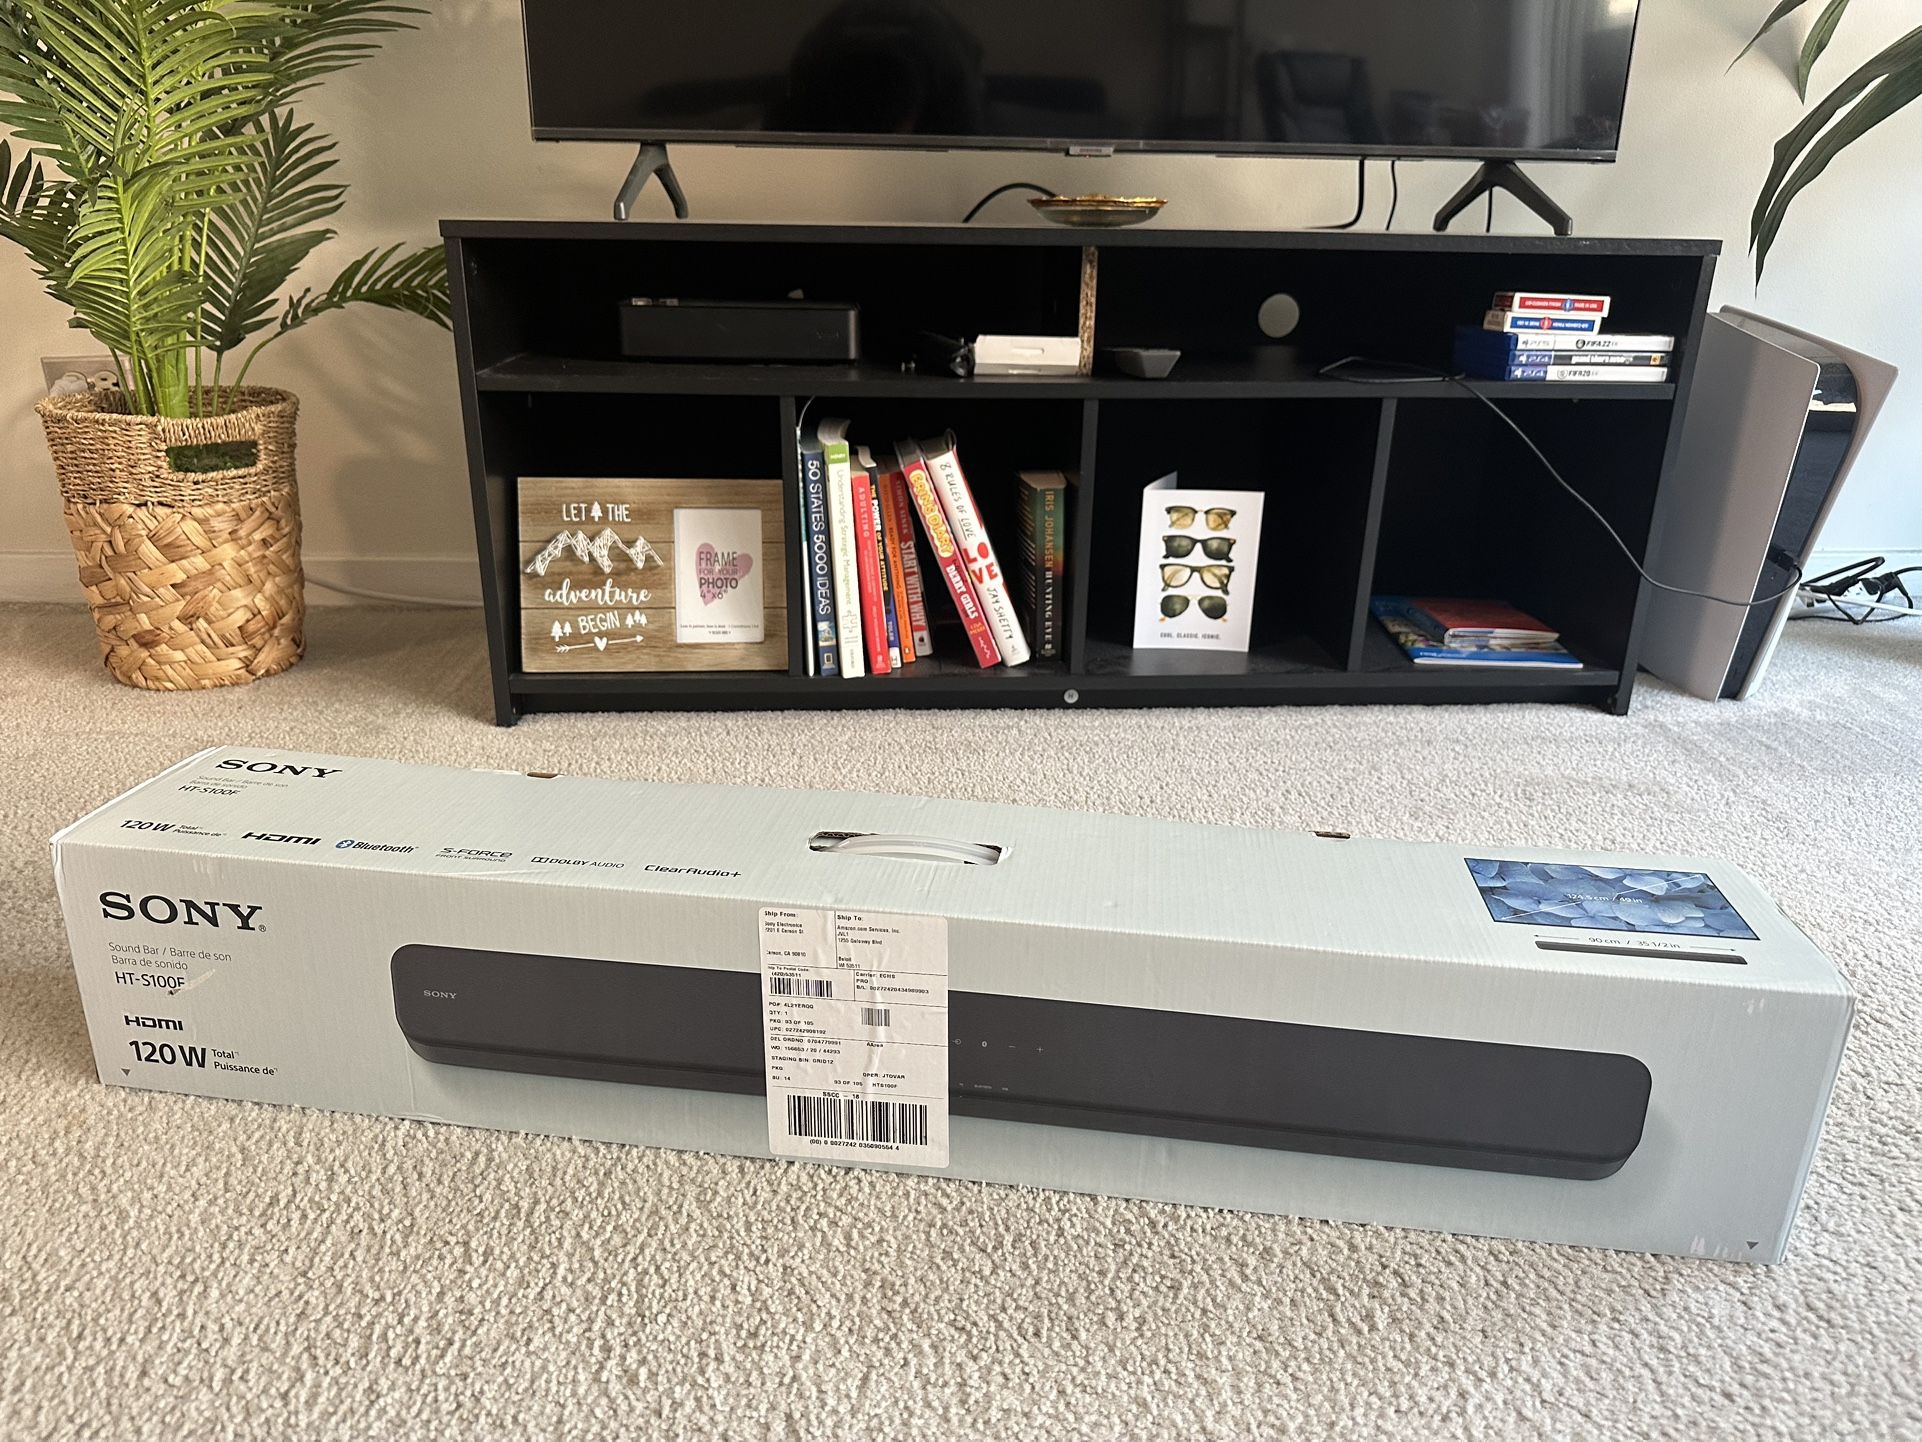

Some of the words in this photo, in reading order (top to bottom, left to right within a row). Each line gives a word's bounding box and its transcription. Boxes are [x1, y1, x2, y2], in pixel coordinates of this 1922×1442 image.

[808, 460, 821, 480] 50
[940, 463, 951, 471] 8
[837, 469, 848, 524] Understanding
[946, 473, 962, 502] RULES
[809, 483, 825, 531] STATES
[956, 505, 967, 514] OF
[1045, 491, 1054, 512] IRIS
[563, 503, 587, 521] LET
[606, 503, 632, 522] THE
[858, 487, 870, 537] ADULTING
[872, 499, 881, 531] POWER
[876, 532, 882, 540] OF
[928, 514, 954, 553] DIARY
[961, 518, 976, 538] LOVE
[840, 524, 849, 557] Strategic
[1044, 515, 1054, 568] JOHANSEN
[699, 551, 738, 567] FRAME
[813, 534, 828, 574] 5000
[900, 541, 918, 571] START
[699, 568, 714, 576] FOR
[718, 568, 738, 576] YOUR
[843, 559, 851, 605] Management
[880, 560, 888, 591] ATTITUDE
[544, 578, 652, 605] adventure
[699, 577, 739, 589] PHOTO
[905, 575, 922, 602] WITH
[946, 564, 967, 594] DERRY
[961, 594, 979, 619] GIRLS
[817, 577, 831, 615] IDEAS
[1044, 571, 1053, 618] HUNTING
[578, 610, 620, 634] BEGIN
[909, 603, 927, 626] WHY
[987, 587, 999, 605] JAY
[994, 605, 1014, 640] SHETTY
[215, 759, 343, 779] SONY
[178, 785, 241, 796] HT-S100F
[172, 828, 210, 836] Puissance
[241, 832, 321, 845] HDMI
[352, 840, 415, 854] Bluetooth
[440, 847, 512, 858] S-FORCE
[548, 858, 590, 866] DOLBY
[589, 861, 625, 869] AUDIO
[644, 864, 742, 878] ClearAudio+
[108, 942, 141, 954] Sound
[143, 945, 159, 955] Bar
[162, 947, 167, 956] /
[170, 948, 196, 958] Barre
[198, 950, 211, 960] de
[213, 952, 232, 962] son
[111, 955, 137, 966] Barra
[139, 957, 152, 967] de
[155, 959, 188, 970] sonido
[115, 971, 186, 989] HT-S100F
[424, 990, 457, 999] SONY
[124, 1015, 184, 1031] HDMI
[214, 1061, 260, 1074] Puissance
